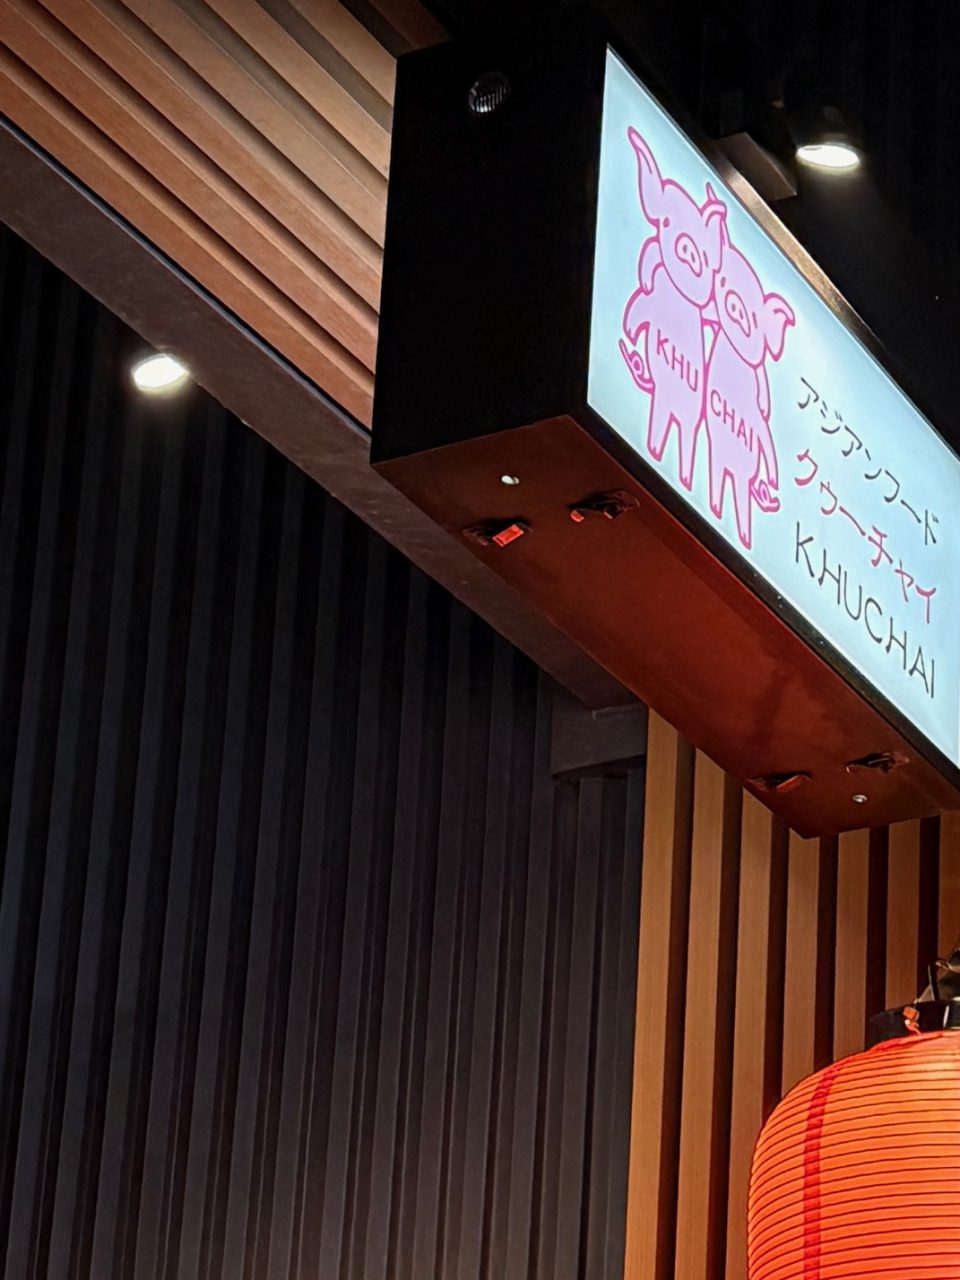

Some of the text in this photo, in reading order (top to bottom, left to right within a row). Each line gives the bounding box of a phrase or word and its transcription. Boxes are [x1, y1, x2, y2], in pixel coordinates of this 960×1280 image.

[656, 328, 698, 393] KHU
[710, 388, 753, 452] CHAI
[797, 376, 939, 546] アジアンフード
[795, 521, 935, 699] KHUCHAI
